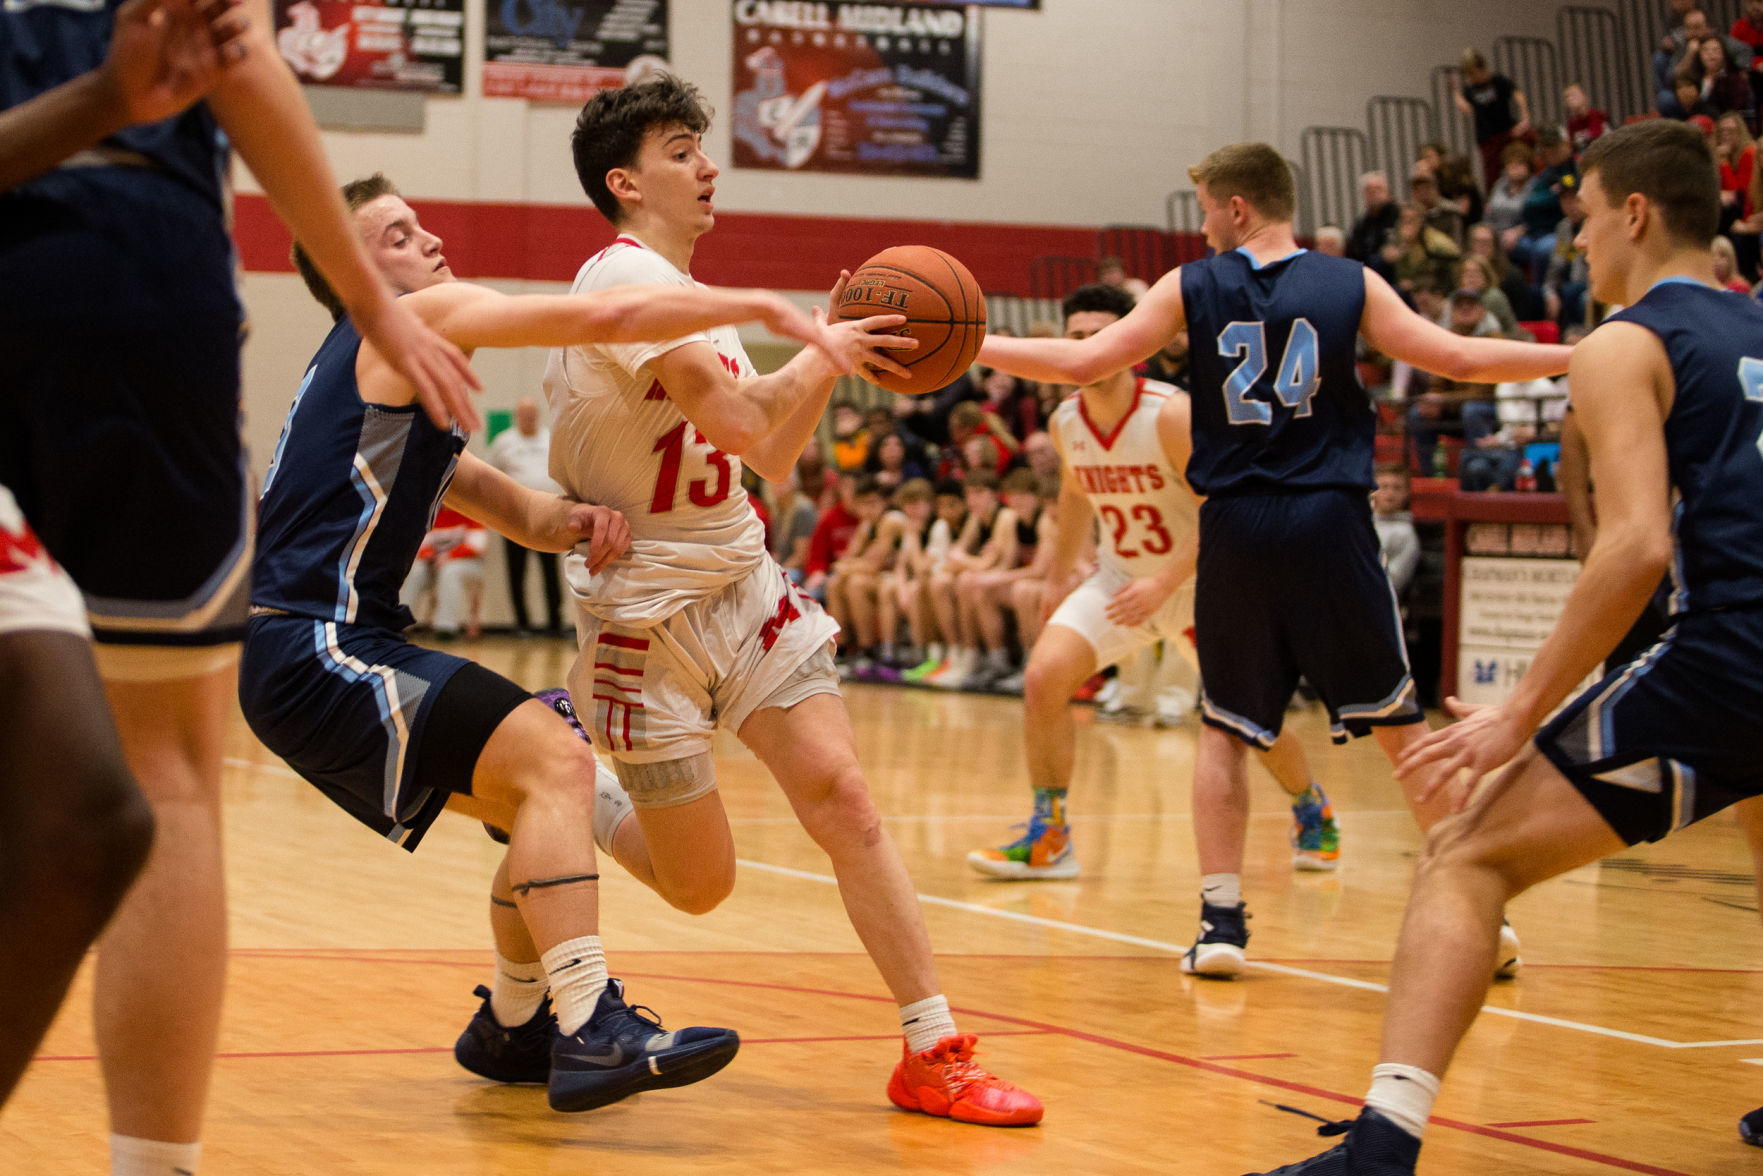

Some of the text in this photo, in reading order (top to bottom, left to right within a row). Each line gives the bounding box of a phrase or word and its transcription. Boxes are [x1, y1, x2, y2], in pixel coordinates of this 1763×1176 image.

[838, 5, 964, 38] MIDLAND
[1216, 317, 1321, 425] 24
[650, 420, 731, 514] 13
[1099, 503, 1174, 559] 23
